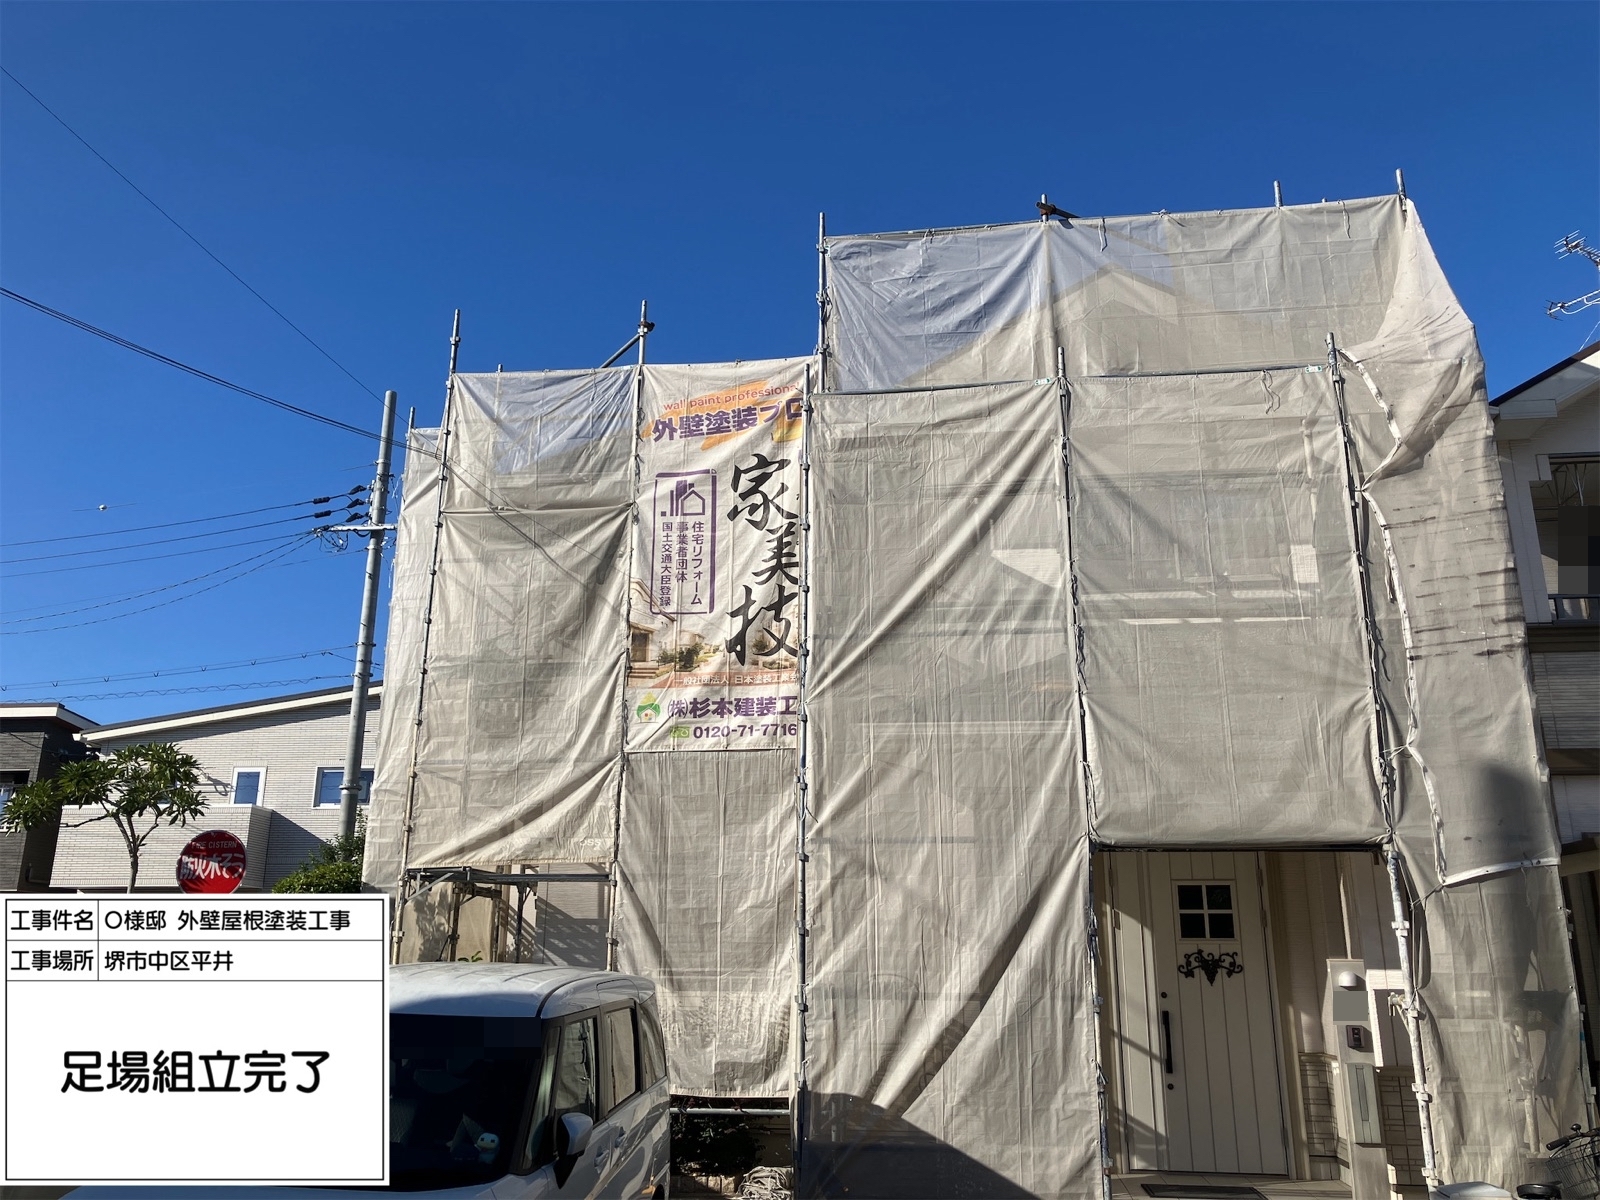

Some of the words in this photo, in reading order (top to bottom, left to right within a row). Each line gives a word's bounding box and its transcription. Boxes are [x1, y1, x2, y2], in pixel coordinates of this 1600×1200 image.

[652, 396, 803, 443] 外壁塗装プロ
[663, 399, 687, 411] wall
[690, 395, 721, 409] paint
[724, 382, 800, 403] professional
[659, 521, 673, 607] 国土交通大臣登録
[675, 521, 689, 584] 事業者団体
[690, 520, 705, 606] 住宅リフォーム
[693, 723, 798, 739] 0120-71-7716
[191, 841, 207, 849] FIRE
[208, 840, 237, 849] CISTERN
